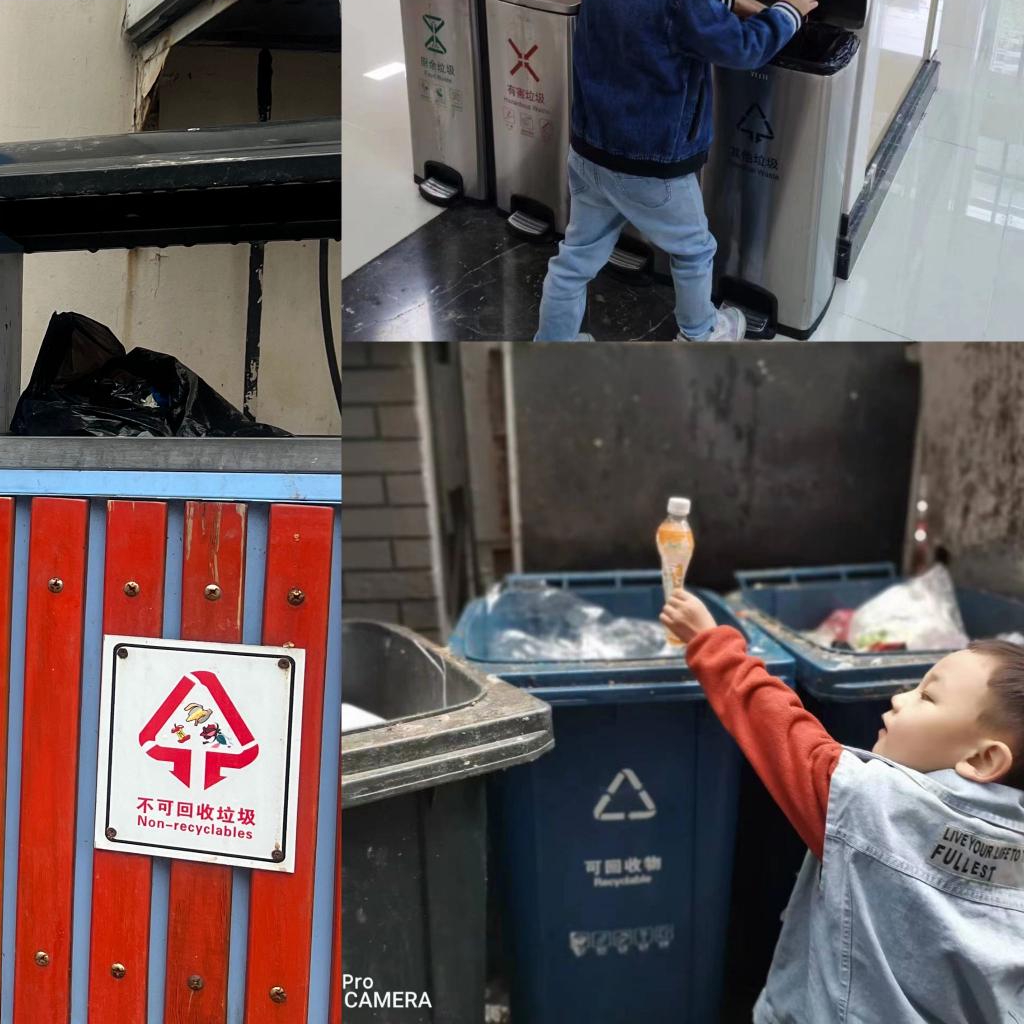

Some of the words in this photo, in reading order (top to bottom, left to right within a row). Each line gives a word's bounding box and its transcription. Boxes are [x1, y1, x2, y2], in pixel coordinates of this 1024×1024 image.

[507, 85, 544, 104] 有害垃圾
[136, 797, 256, 826] 不可回收垃圾
[137, 815, 253, 839] Non-recyclables
[943, 827, 969, 847] LIVE
[968, 836, 994, 858] YOUR
[992, 846, 1011, 860] LIFE
[930, 844, 997, 881] FULLEST
